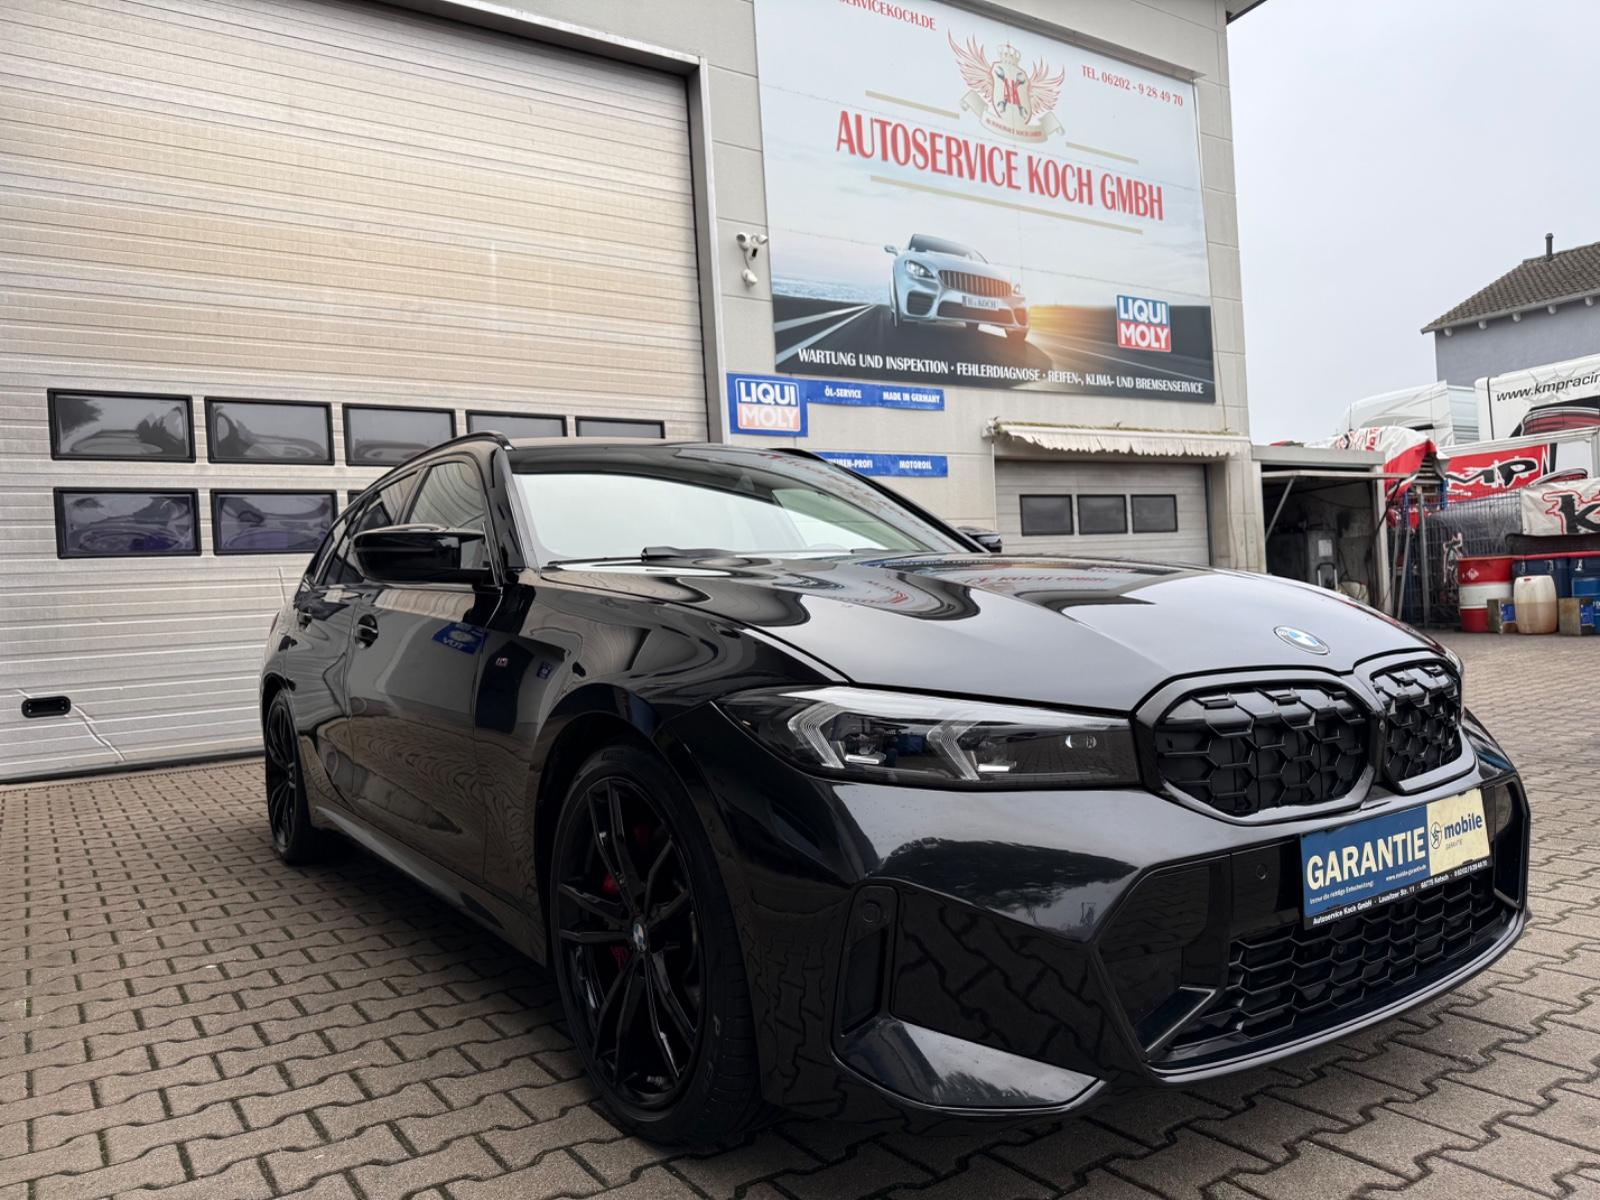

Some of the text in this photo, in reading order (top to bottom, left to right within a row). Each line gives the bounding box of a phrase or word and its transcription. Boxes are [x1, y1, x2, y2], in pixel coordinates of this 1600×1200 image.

[1081, 64, 1100, 81] TEL.
[1101, 71, 1131, 91] 06202
[1138, 83, 1144, 95] 9
[1159, 91, 1171, 103] 49
[1172, 94, 1183, 106] 70
[836, 110, 1164, 221] AUTOSERVICE KOCH GMBH
[1118, 296, 1168, 325] LIQUI
[1120, 323, 1169, 349] MOLY
[798, 348, 857, 367] WARTUNG
[859, 353, 883, 369] UND
[886, 356, 949, 374] INSPEKTION
[957, 362, 1041, 382] FEHLERDIAGNOSE
[1086, 373, 1115, 387] KLIMA-
[1117, 375, 1134, 389] UND
[1136, 379, 1204, 394] BREMSENSERVICE
[739, 381, 796, 406] LIQUI
[824, 385, 862, 399] ÖL-SERVICE
[883, 391, 940, 404] MADE IN GERMANY
[741, 405, 799, 429] MOLY
[899, 461, 932, 470] MOTOROIL
[1443, 812, 1483, 840] mobile
[1306, 826, 1427, 890] GARANTIE
[1312, 909, 1343, 926] Autoservice
[1343, 905, 1357, 915] Koch
[1357, 899, 1373, 911] GmbH
